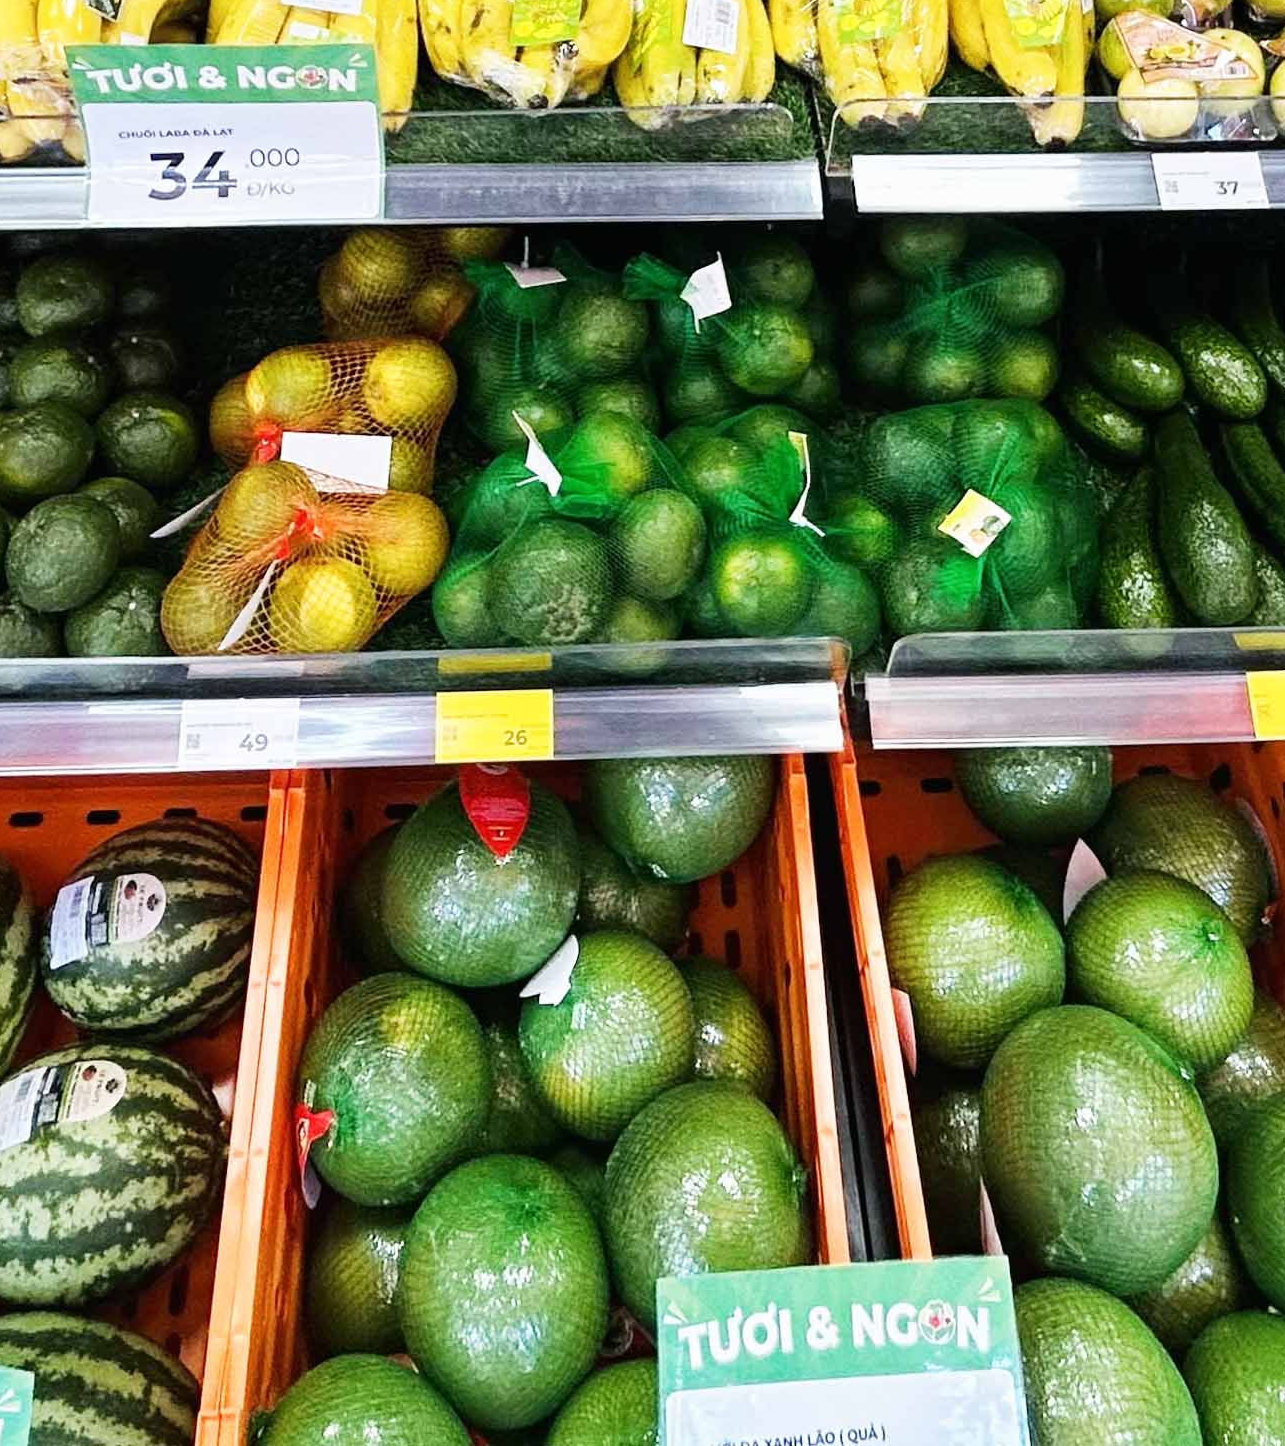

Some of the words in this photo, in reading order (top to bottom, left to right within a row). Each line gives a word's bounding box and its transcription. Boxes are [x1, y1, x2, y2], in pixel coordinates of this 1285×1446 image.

[86, 61, 187, 94] TƯƠI
[198, 66, 227, 91] &
[148, 150, 237, 202] 34
[1216, 181, 1239, 195] 37
[238, 734, 268, 753] 49
[504, 730, 528, 746] 26
[678, 1300, 793, 1371] TƯƠI
[806, 1305, 840, 1350] &
[851, 1299, 990, 1353] NGON
